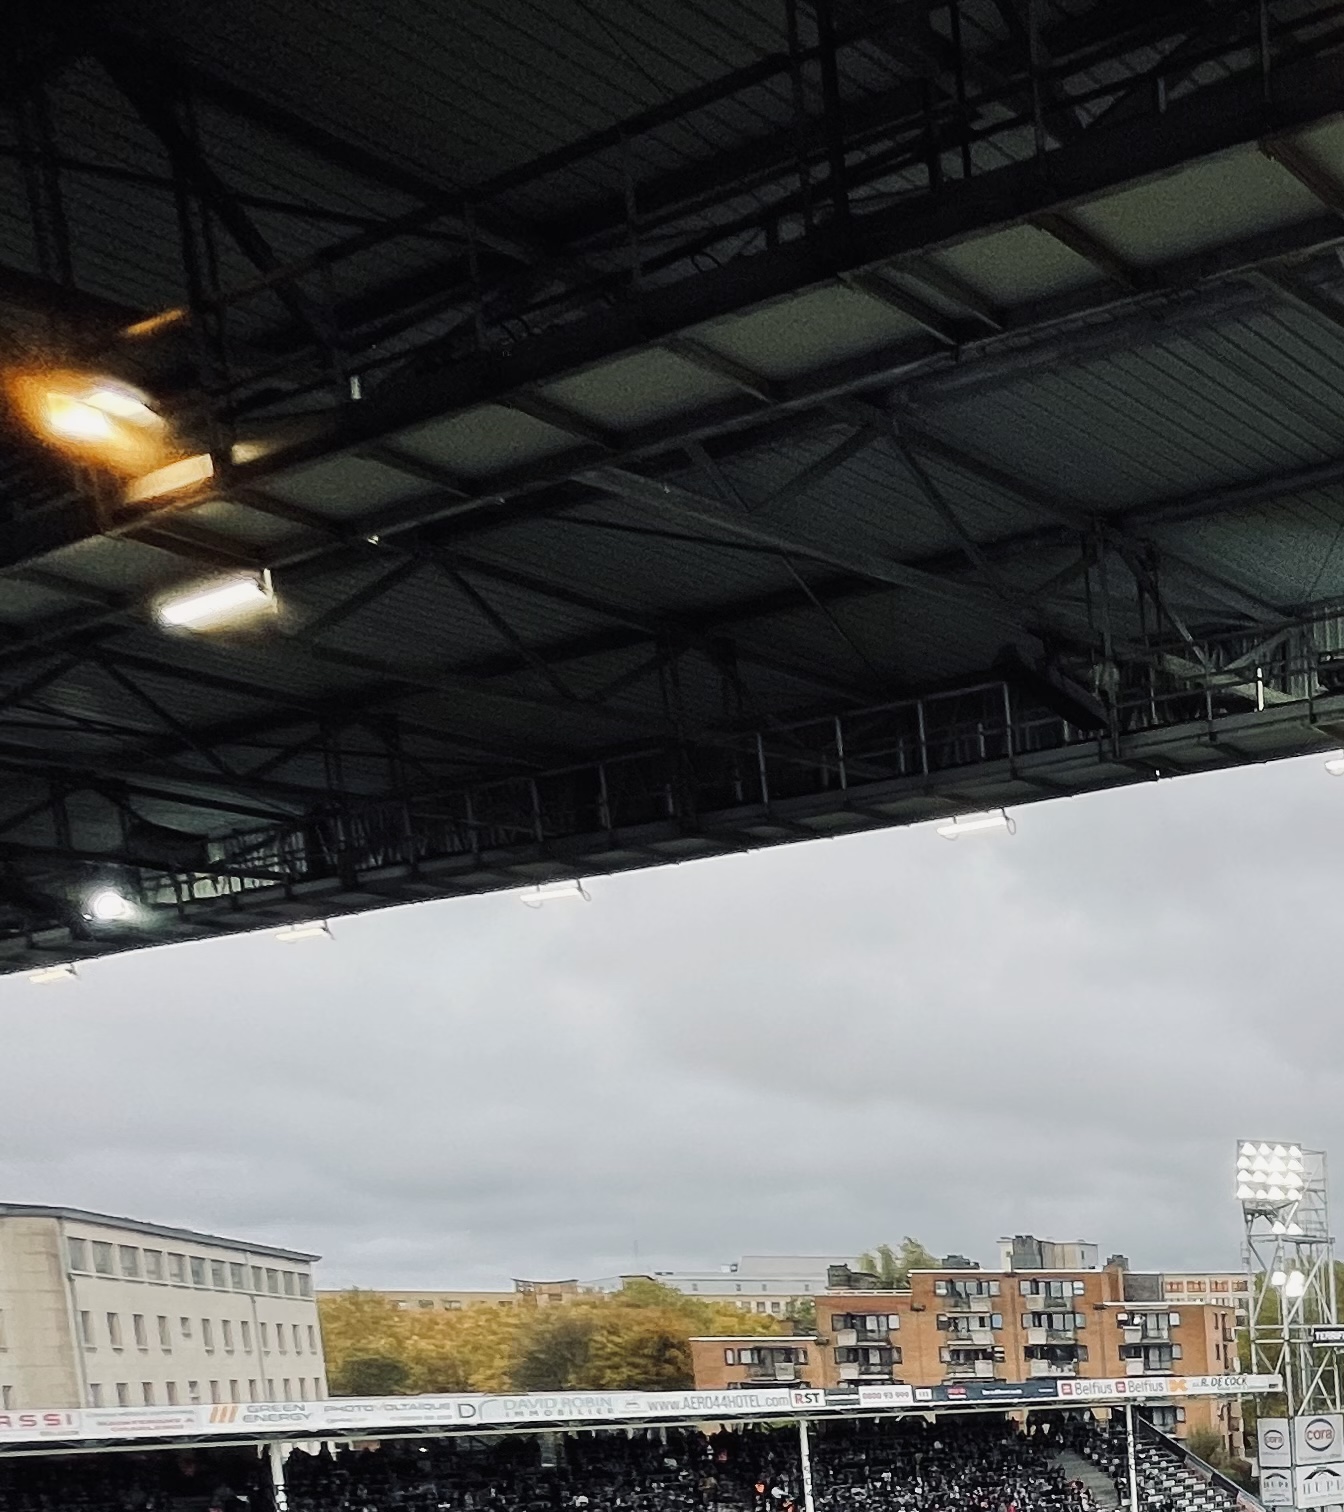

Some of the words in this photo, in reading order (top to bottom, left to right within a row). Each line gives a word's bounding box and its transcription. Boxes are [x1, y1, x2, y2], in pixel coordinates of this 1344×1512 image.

[1074, 1381, 1112, 1395] Belfius
[1128, 1379, 1164, 1393] Belfius
[504, 1398, 560, 1410] DAVID
[794, 1393, 820, 1404] RST
[246, 1403, 306, 1413] GREEN
[505, 1408, 615, 1418] IMMOBILIER
[242, 1413, 313, 1423] ENERGY
[1307, 1429, 1333, 1441] cora
